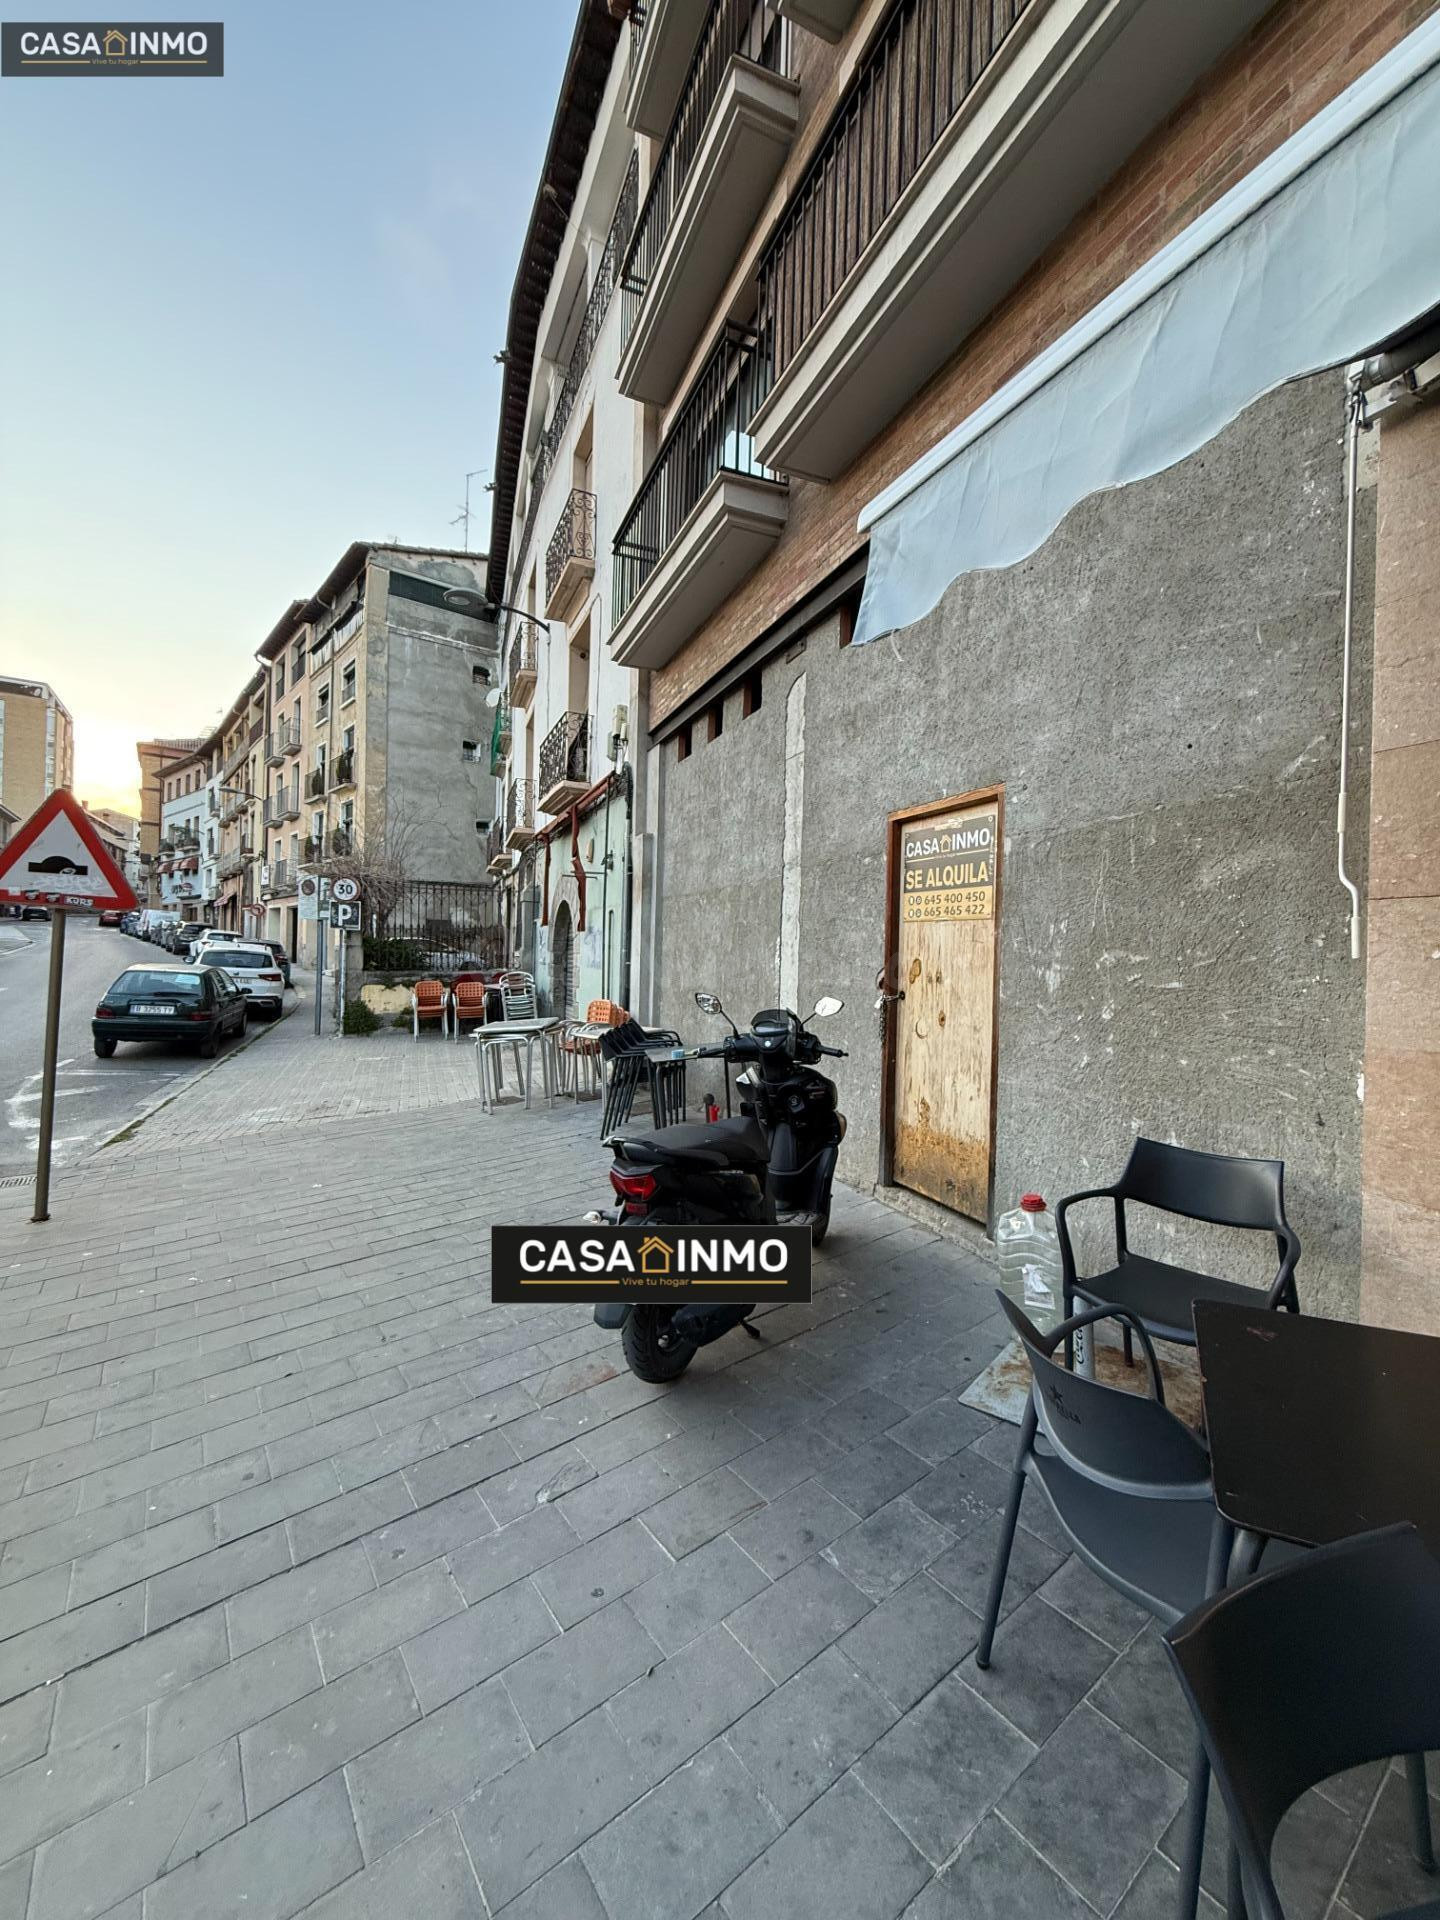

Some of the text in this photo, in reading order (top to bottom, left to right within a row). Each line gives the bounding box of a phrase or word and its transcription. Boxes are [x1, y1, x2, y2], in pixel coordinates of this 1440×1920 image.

[907, 828, 990, 858] CASA INMO
[905, 861, 988, 889] SE ALQUILA
[338, 884, 353, 895] 30
[924, 891, 985, 905] 645 400 450
[338, 904, 352, 926] P
[924, 904, 985, 917] 665 465 422
